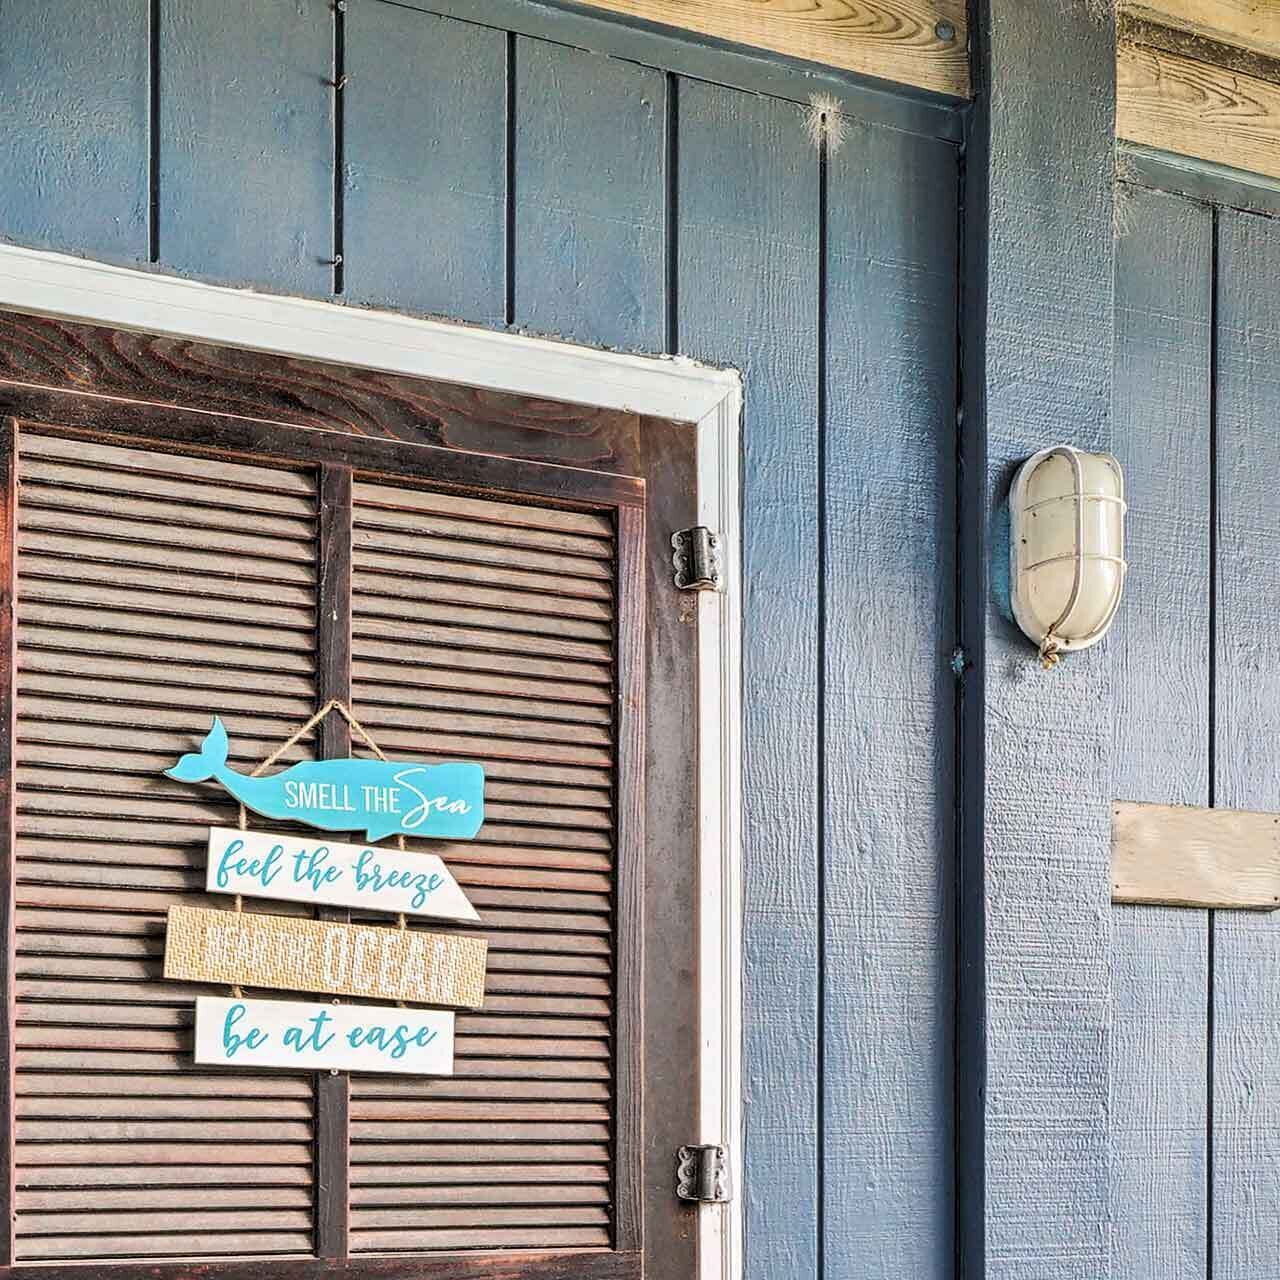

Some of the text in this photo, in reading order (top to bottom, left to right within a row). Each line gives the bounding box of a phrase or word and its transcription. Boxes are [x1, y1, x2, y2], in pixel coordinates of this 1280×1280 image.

[284, 767, 472, 829] SMELL THE Sea
[216, 839, 445, 910] feel the breeze
[323, 926, 458, 998] OCEAN
[223, 1004, 438, 1059] be at ease
